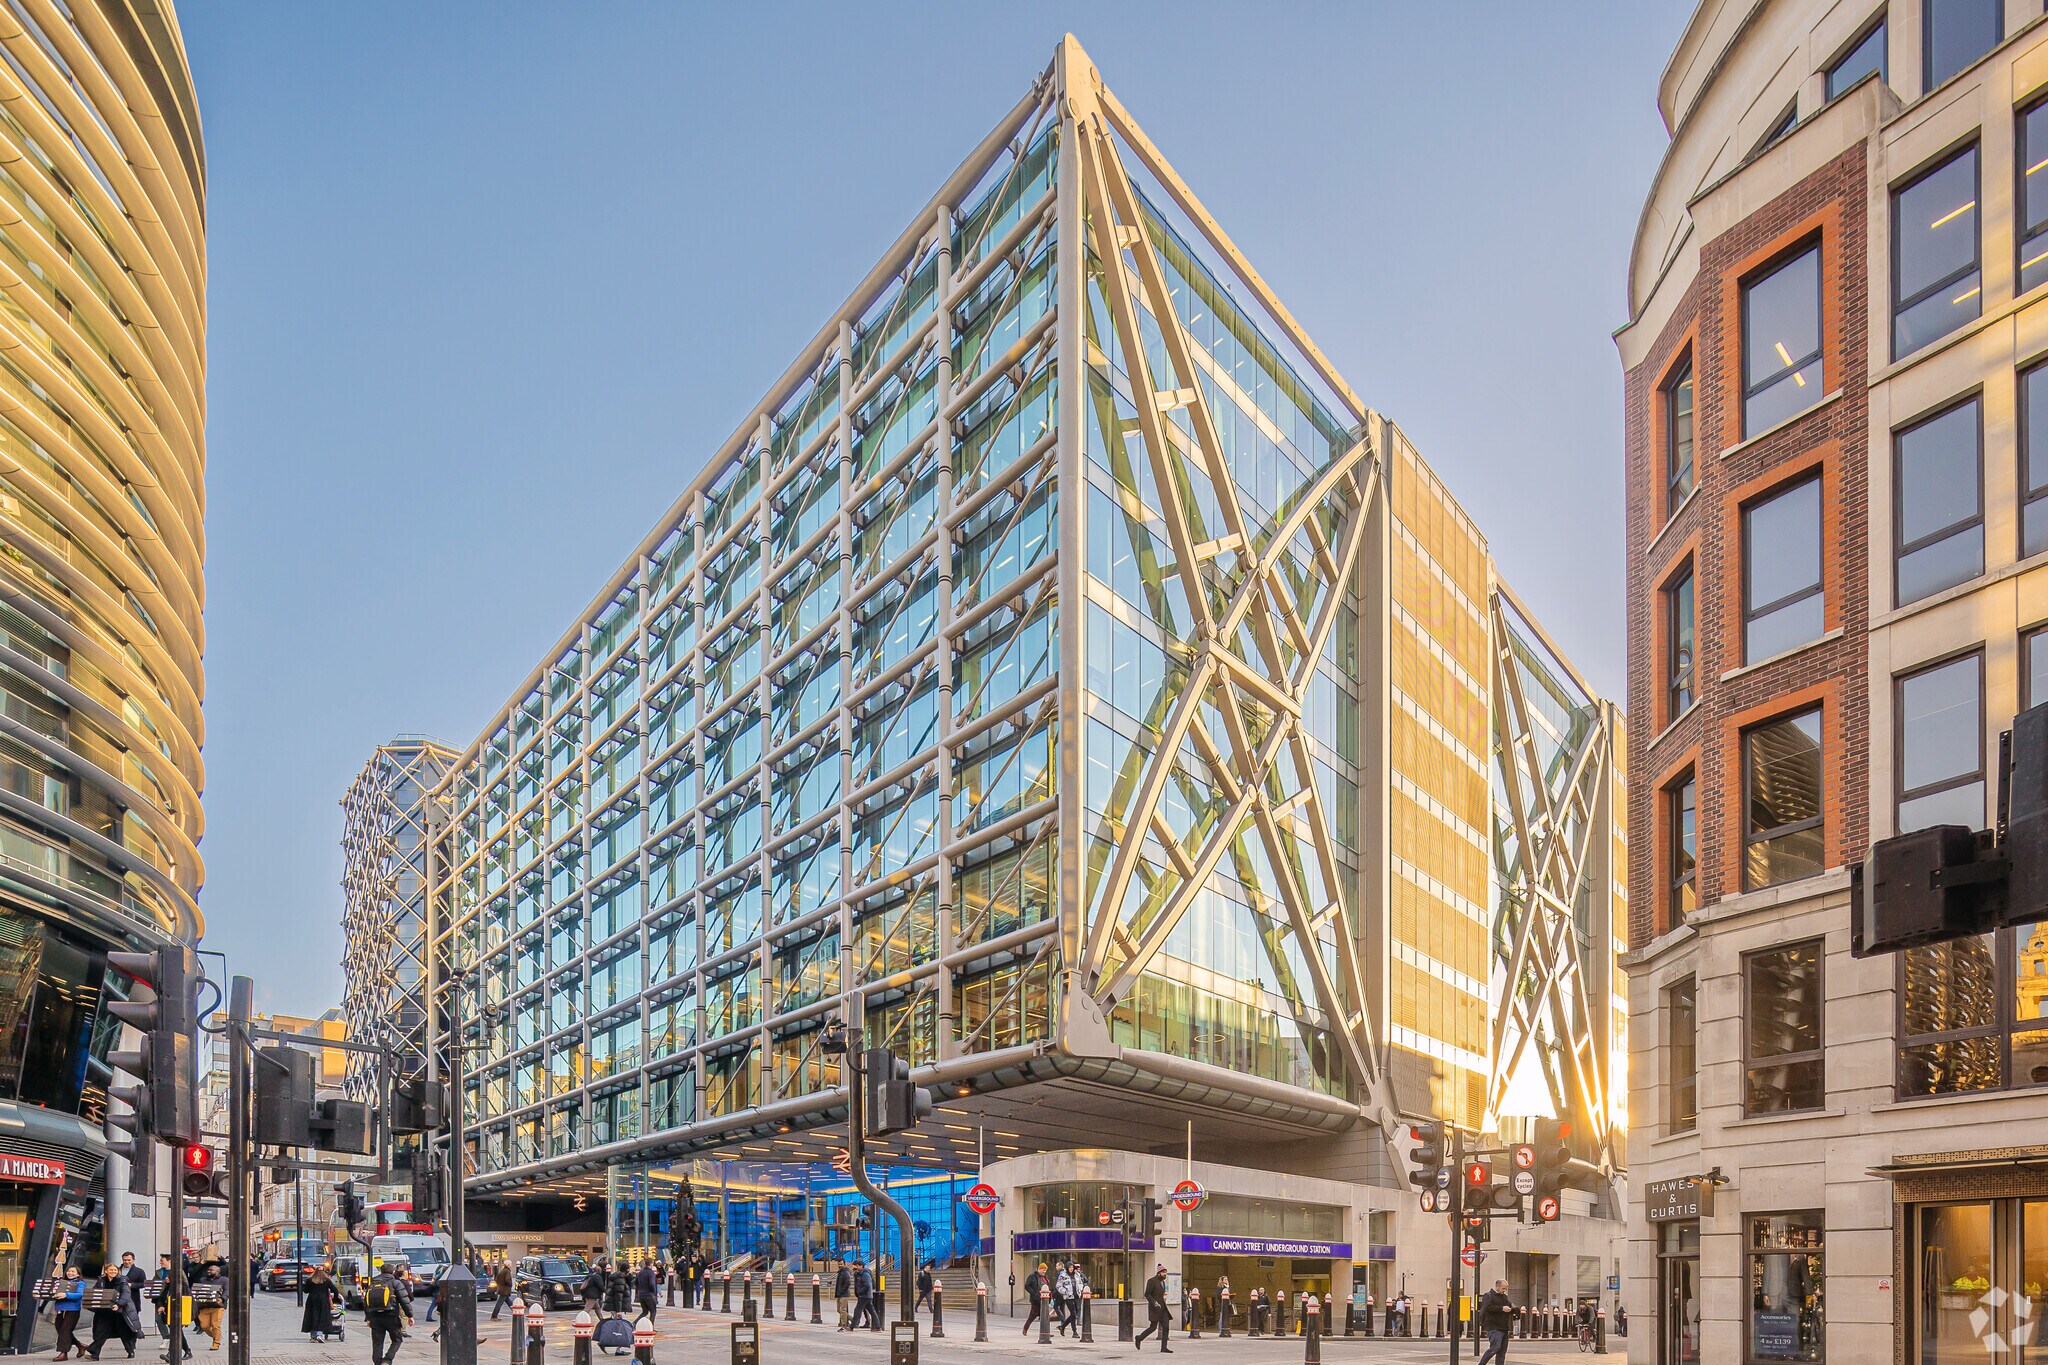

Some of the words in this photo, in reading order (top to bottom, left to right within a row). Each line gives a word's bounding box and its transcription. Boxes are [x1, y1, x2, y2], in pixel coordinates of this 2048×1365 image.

[3, 1159, 10, 1174] A
[13, 1160, 50, 1179] MANGER
[1669, 1194, 1677, 1203] &
[1651, 1203, 1697, 1218] CURTIS
[1213, 1240, 1242, 1251] CANNON
[1244, 1241, 1265, 1252] STREET
[1266, 1243, 1309, 1254] UNDERGROUND
[1309, 1245, 1331, 1254] STATION
